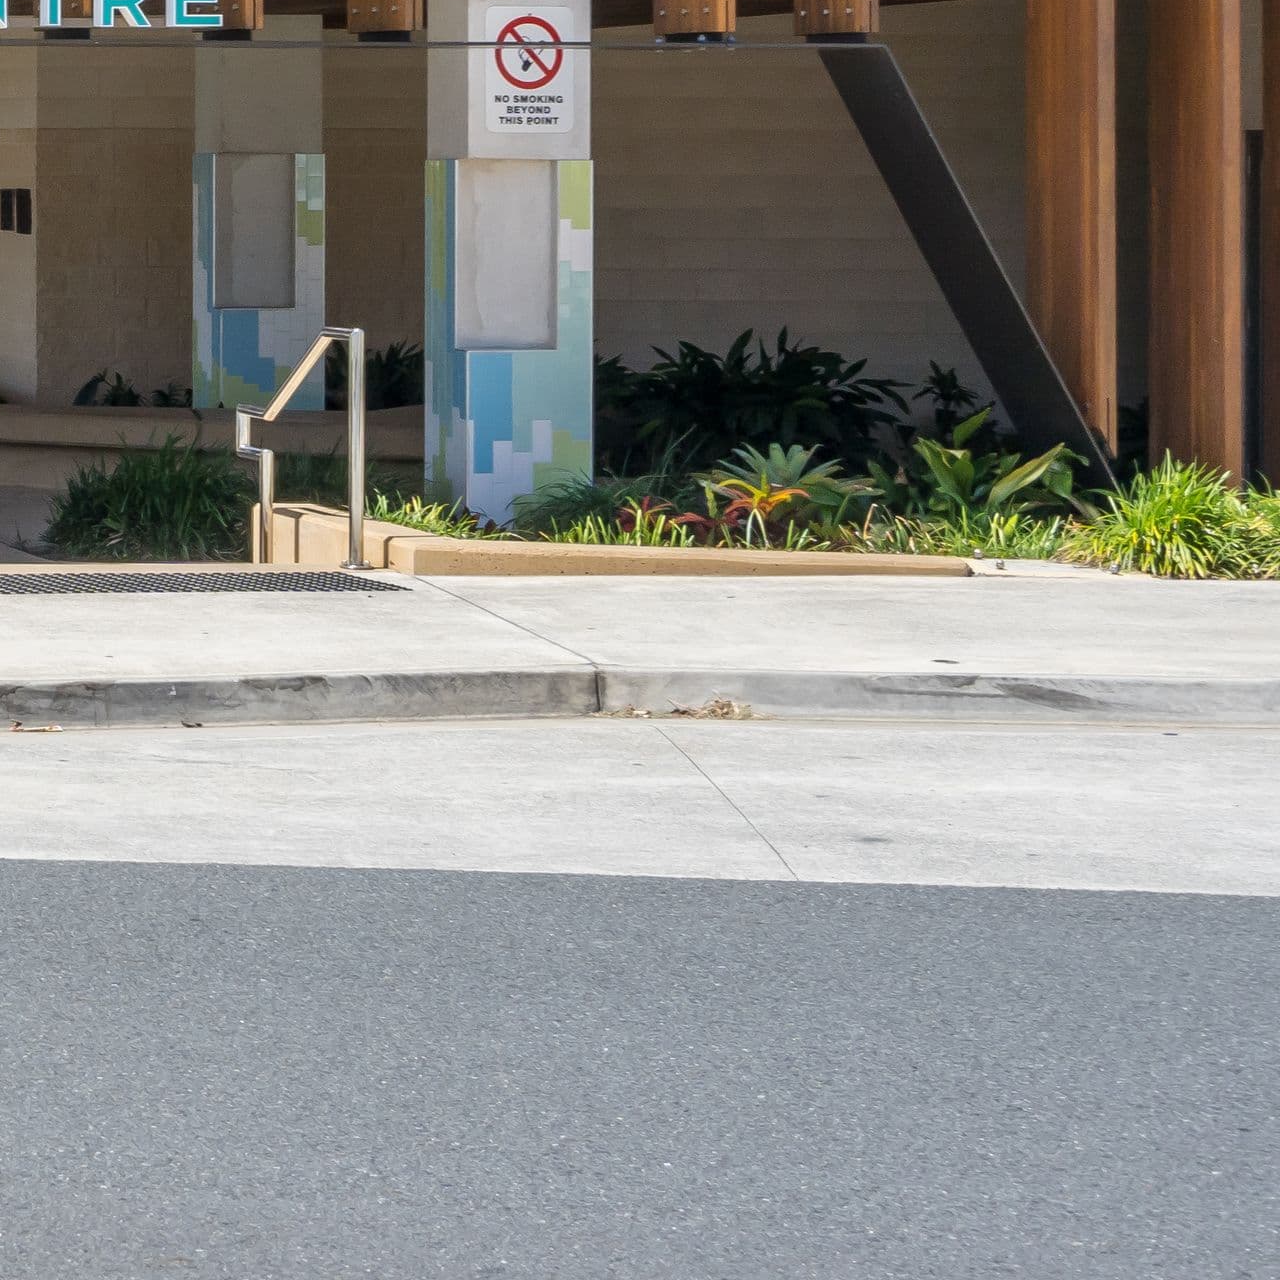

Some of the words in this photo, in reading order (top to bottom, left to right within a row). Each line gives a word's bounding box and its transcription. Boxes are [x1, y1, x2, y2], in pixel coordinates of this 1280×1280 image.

[494, 95, 510, 103] NO
[513, 95, 564, 104] SMOKING
[506, 105, 551, 114] BEYOND
[498, 116, 524, 125] THIS
[526, 116, 559, 125] POINT
